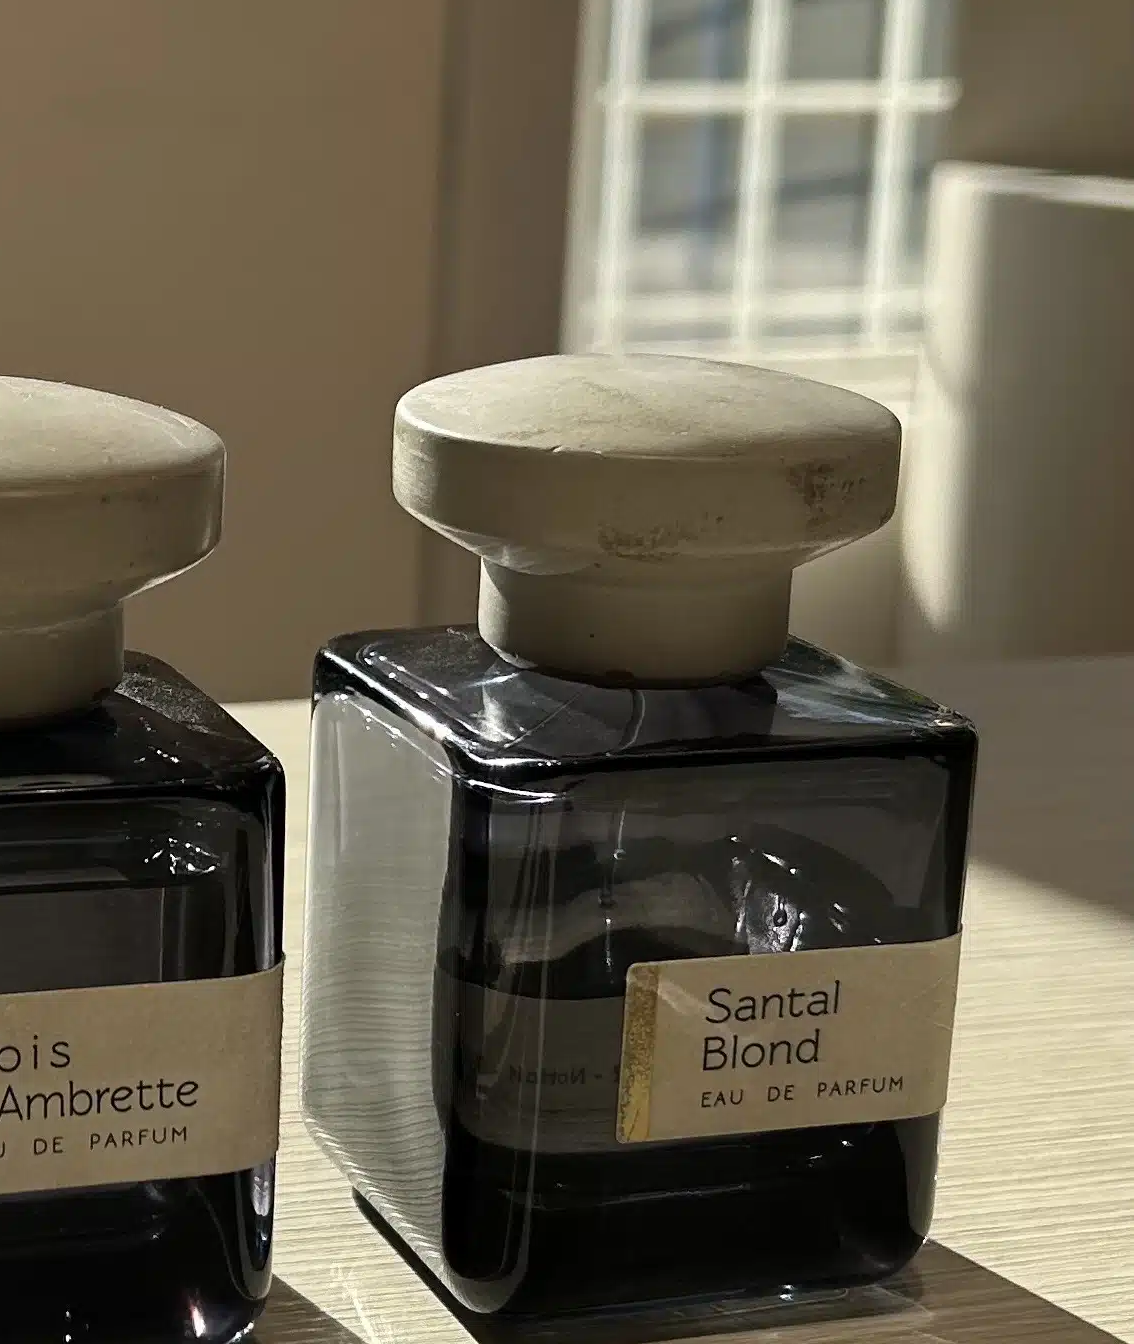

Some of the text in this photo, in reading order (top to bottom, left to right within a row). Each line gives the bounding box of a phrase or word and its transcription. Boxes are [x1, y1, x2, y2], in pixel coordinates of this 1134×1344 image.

[704, 979, 841, 1025] Santal
[701, 1028, 821, 1072] Blond
[700, 1075, 905, 1109] EAU DE PARFUM
[32, 1136, 65, 1156] DE
[89, 1125, 189, 1151] PARFUM
